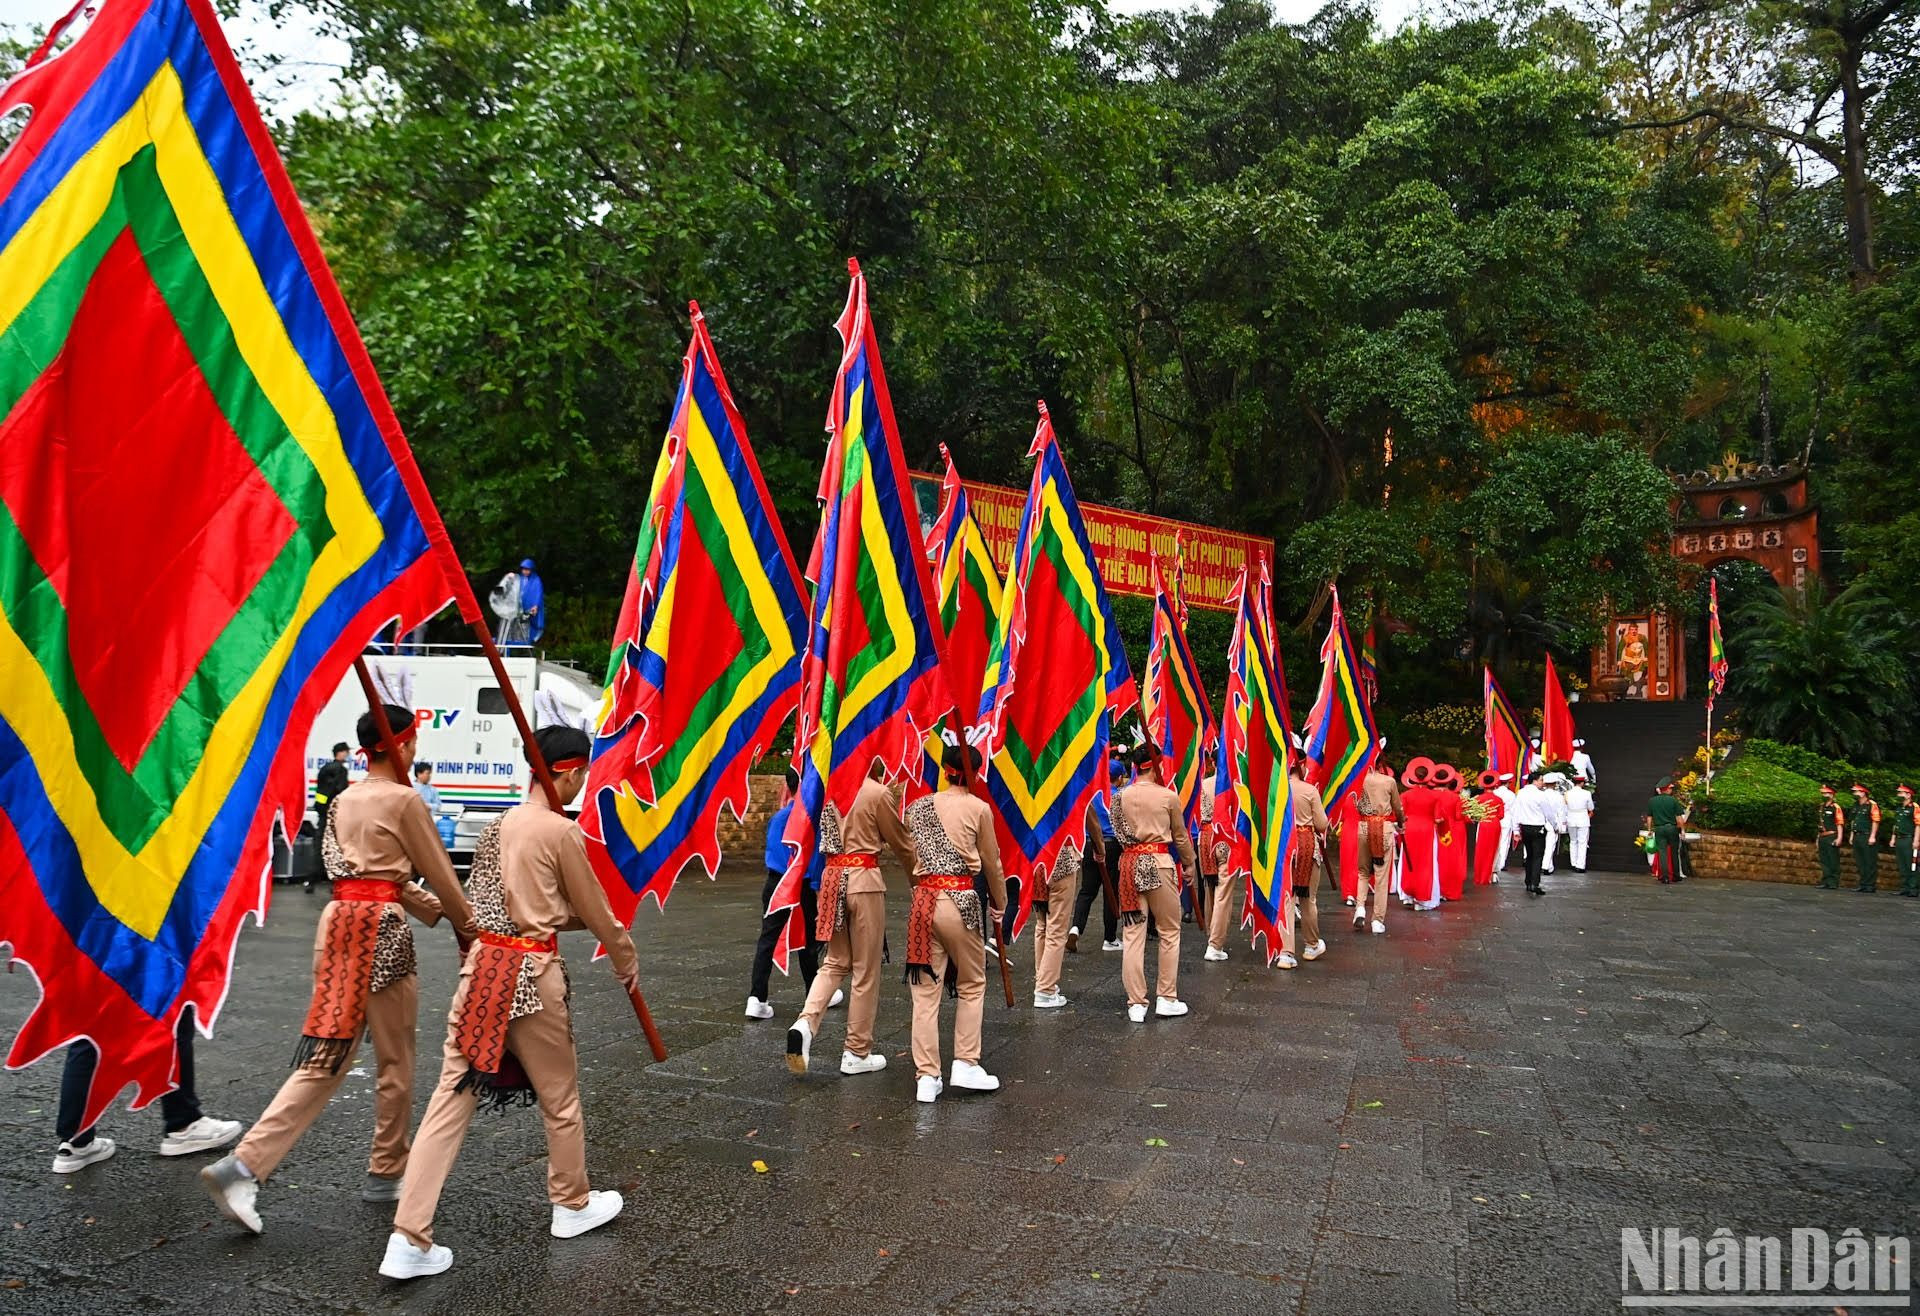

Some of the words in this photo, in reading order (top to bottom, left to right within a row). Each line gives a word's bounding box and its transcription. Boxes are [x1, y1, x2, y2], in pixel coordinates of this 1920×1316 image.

[1083, 517, 1112, 547] ÚNG
[1115, 523, 1146, 553] HÙNG
[1201, 541, 1222, 566] PHÚ
[416, 709, 460, 729] PTV
[472, 720, 493, 732] HD
[436, 760, 463, 774] HÌNH
[493, 763, 513, 779] THỌ
